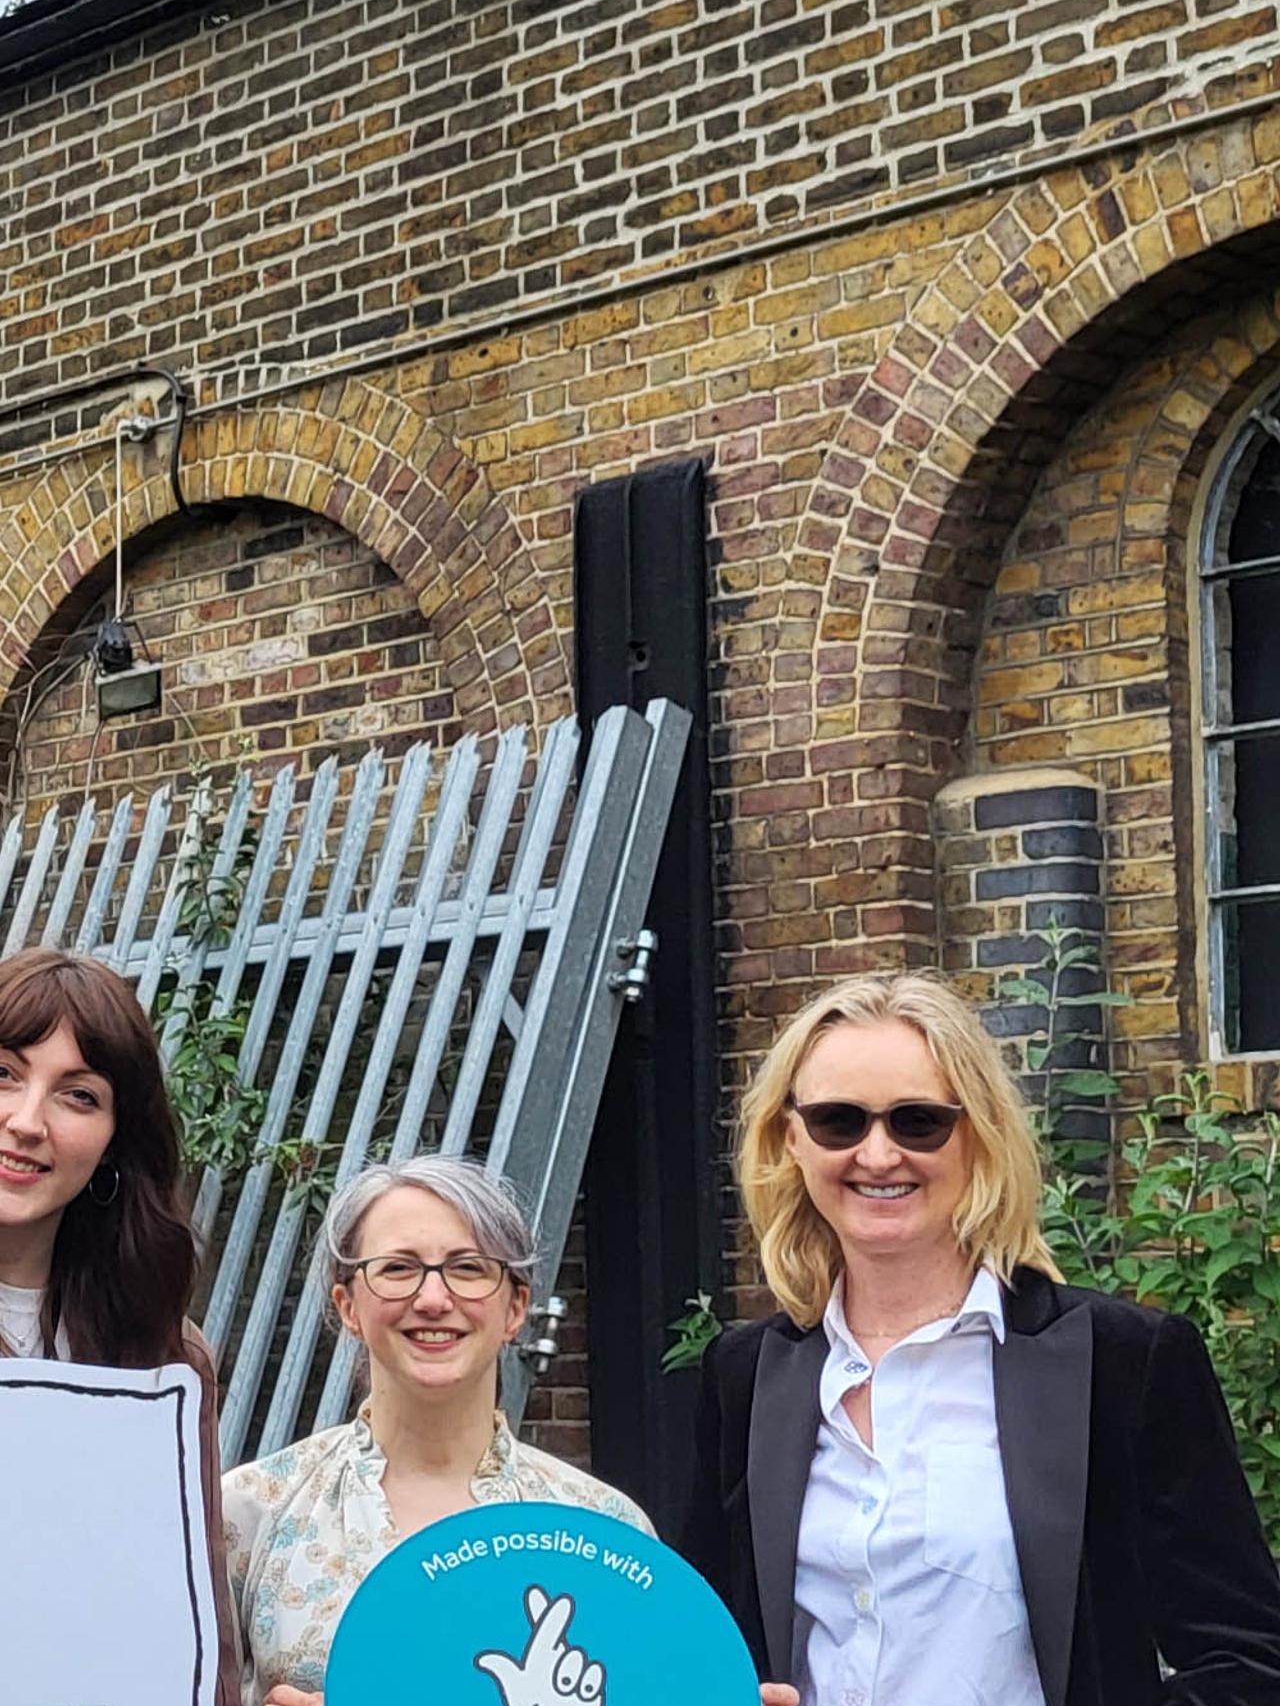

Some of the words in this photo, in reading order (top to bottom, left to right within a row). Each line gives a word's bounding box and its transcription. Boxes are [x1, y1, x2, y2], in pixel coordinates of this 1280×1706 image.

[421, 1539, 488, 1581] Made
[492, 1530, 597, 1559] possible
[603, 1549, 654, 1589] with
